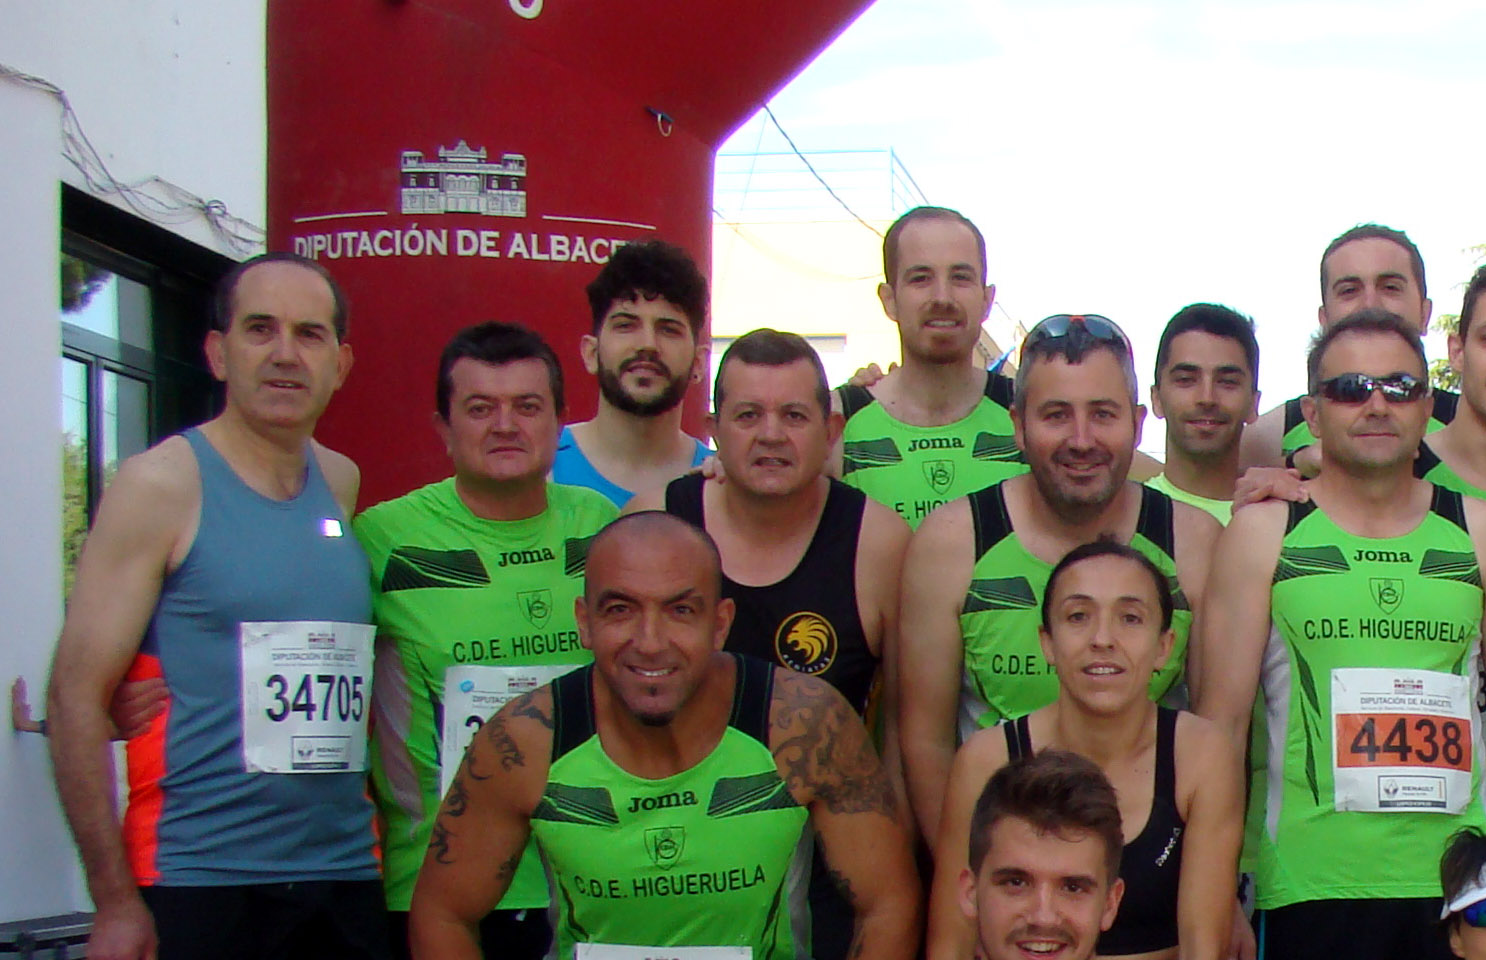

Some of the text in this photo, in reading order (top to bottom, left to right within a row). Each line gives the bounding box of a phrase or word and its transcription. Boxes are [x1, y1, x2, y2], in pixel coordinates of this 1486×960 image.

[294, 223, 627, 264] DIPUTACIÓN DE ALBACE
[907, 434, 965, 453] Joma
[497, 547, 555, 568] Joma
[1353, 549, 1413, 564] Joma
[1304, 618, 1466, 644] C.D.E. HIGUERUELA
[453, 630, 585, 663] C.D.E. HIGUER
[991, 654, 1041, 675] C.D.E.
[265, 674, 364, 723] 34705
[1407, 697, 1419, 705] DE
[1350, 717, 1463, 766] 4438
[628, 790, 698, 814] Joma
[573, 864, 766, 899] C.D.E. HIGUERUELA
